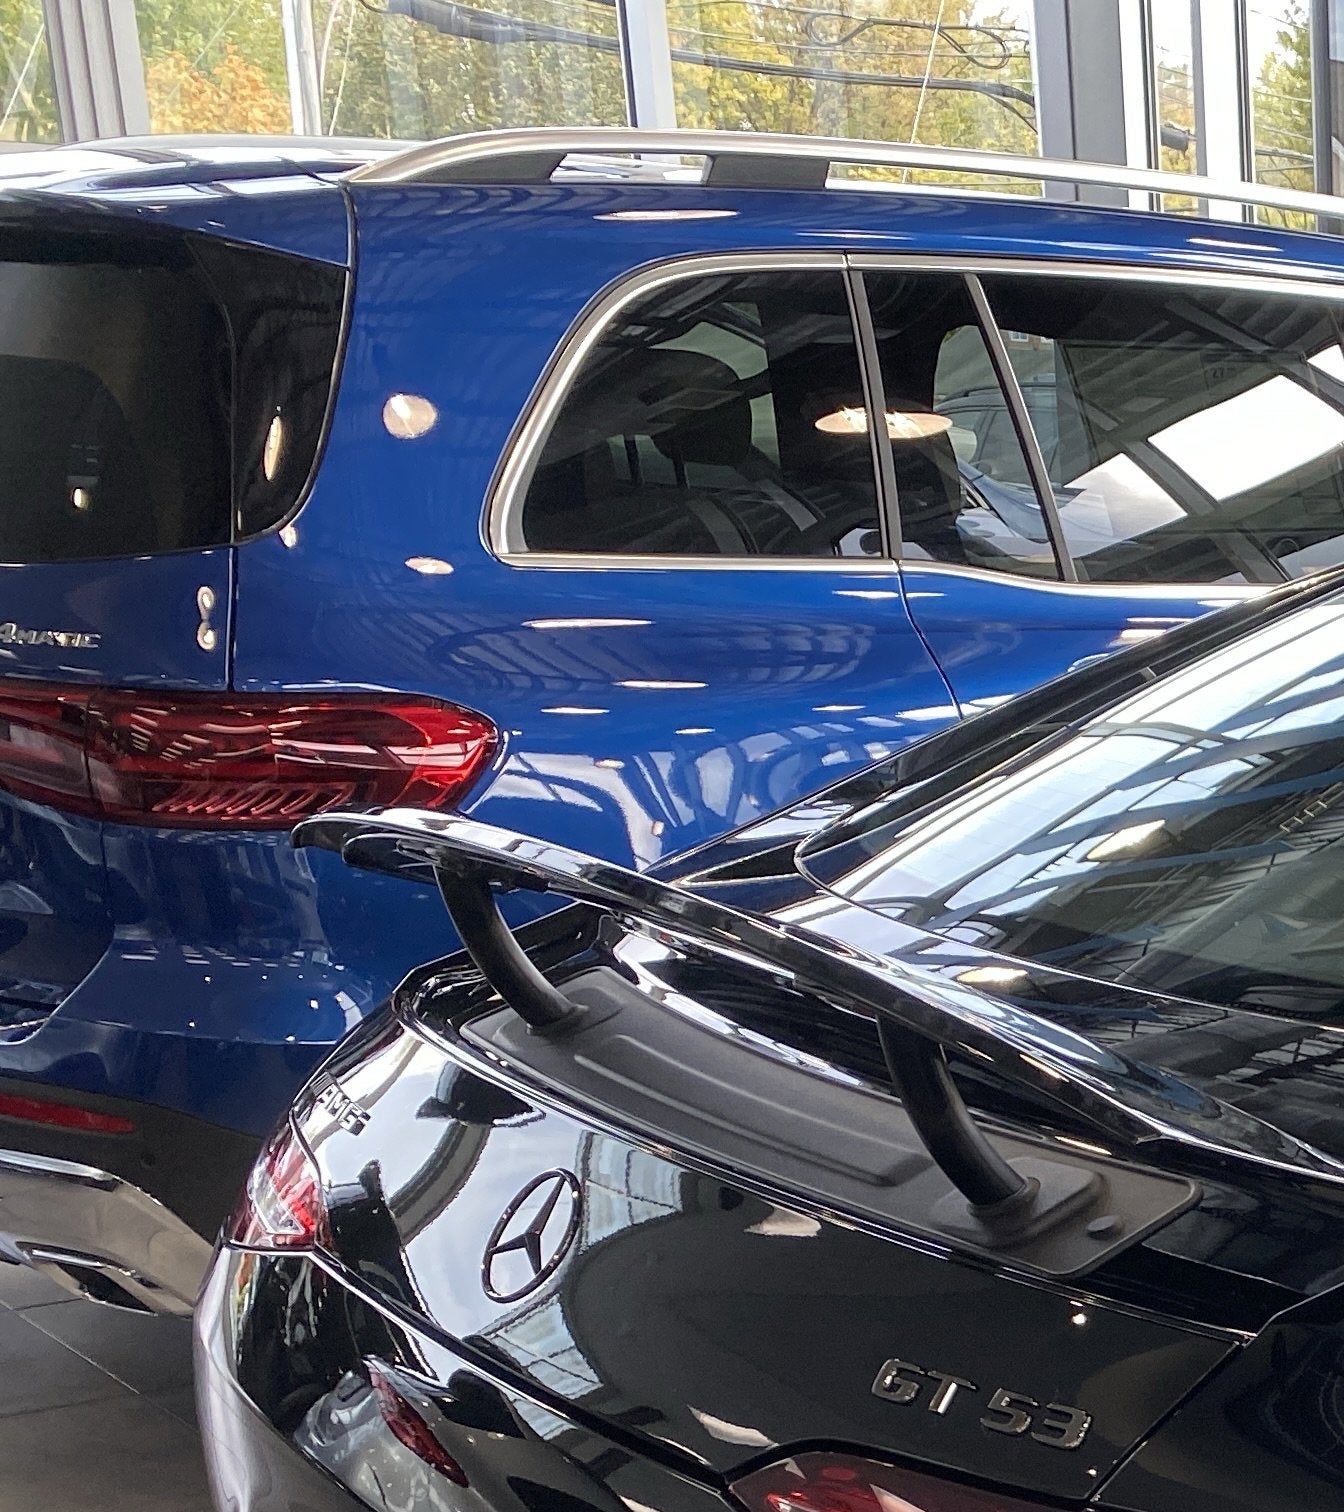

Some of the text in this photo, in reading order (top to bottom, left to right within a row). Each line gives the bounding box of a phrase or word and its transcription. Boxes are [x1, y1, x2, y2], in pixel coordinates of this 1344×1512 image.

[0, 622, 102, 649] 4MATIC
[314, 1083, 371, 1136] AMG
[871, 1358, 1092, 1450] GT 53
